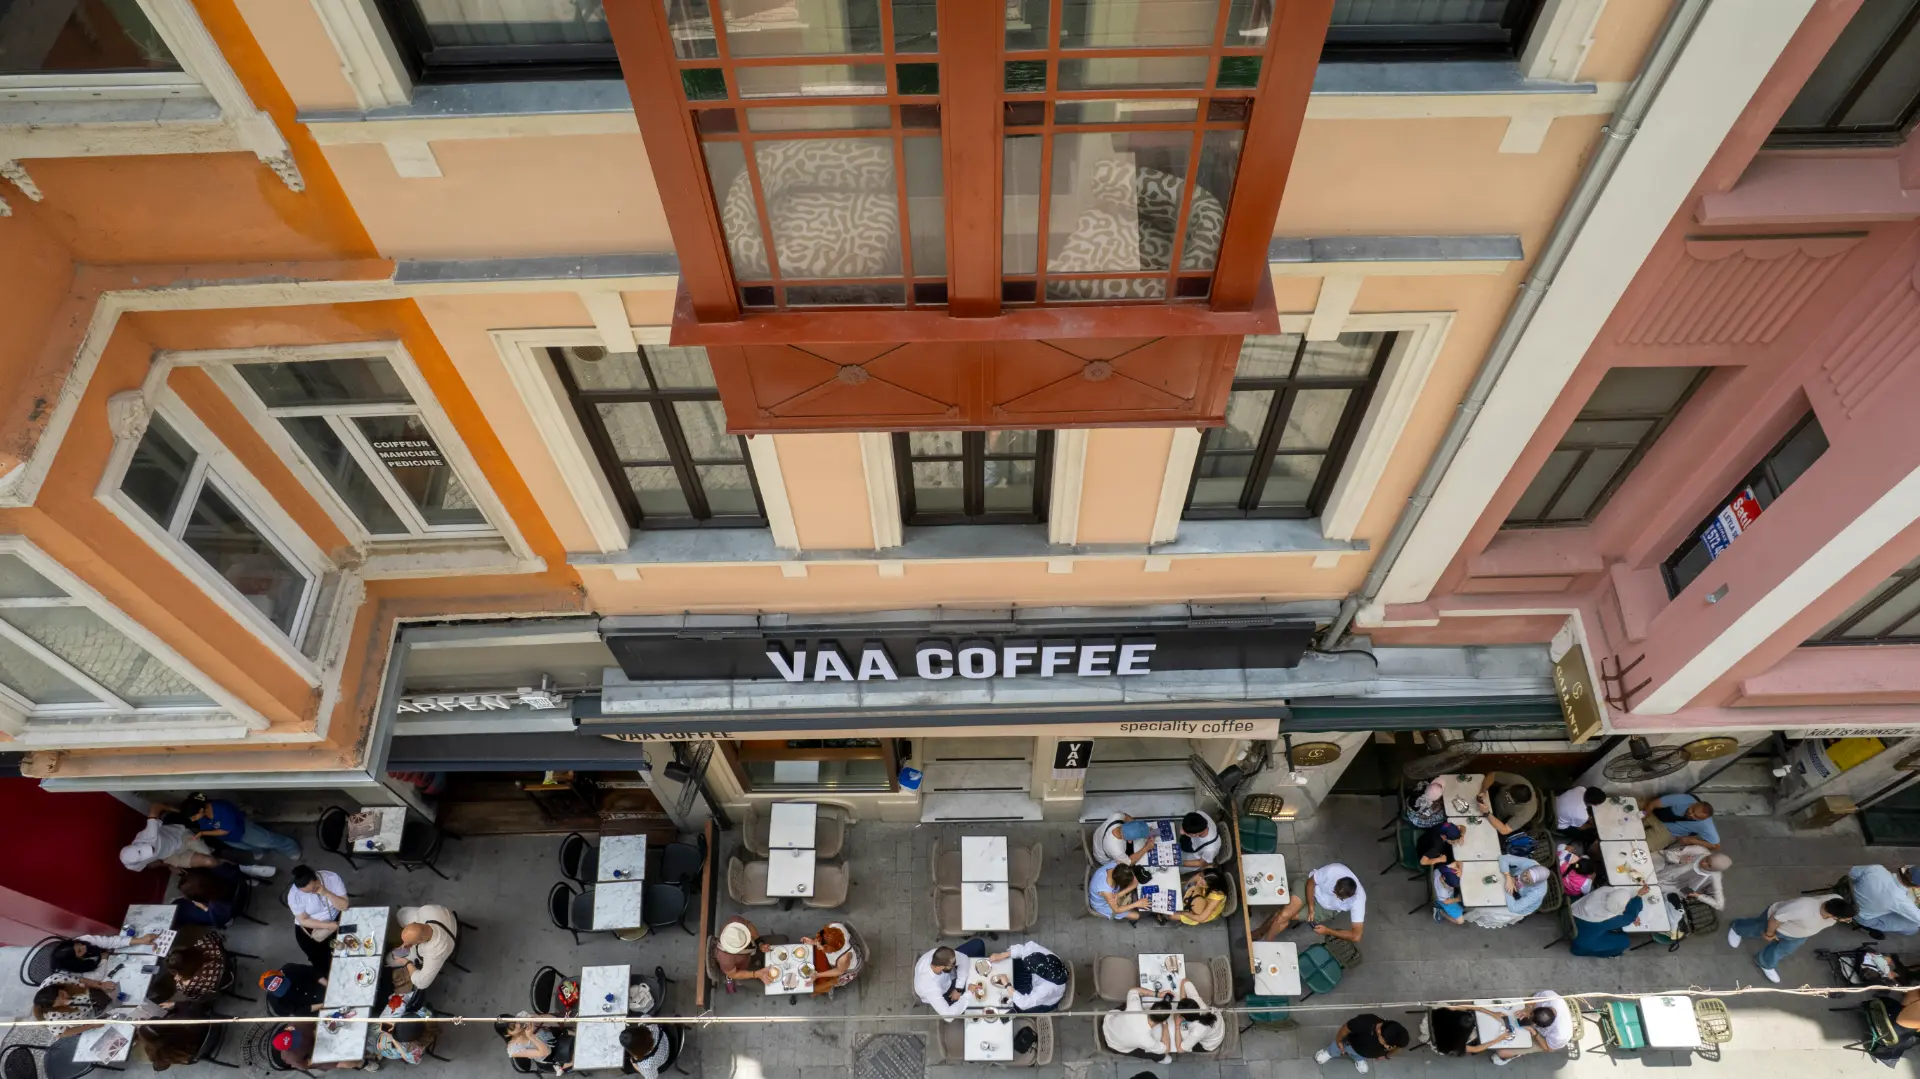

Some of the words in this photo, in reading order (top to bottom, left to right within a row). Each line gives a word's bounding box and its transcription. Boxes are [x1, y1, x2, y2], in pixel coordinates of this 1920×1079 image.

[373, 440, 430, 449] COIFFEUR
[379, 450, 439, 459] MANICURE
[1722, 511, 1736, 532] LEYLA
[1707, 528, 1721, 549] 572
[765, 648, 899, 683] VAA
[916, 643, 1157, 680] COFFEE
[1556, 665, 1580, 736] GALLANT
[1119, 720, 1198, 734] speciality
[1201, 719, 1254, 733] coffee
[1065, 743, 1081, 767] VAA
